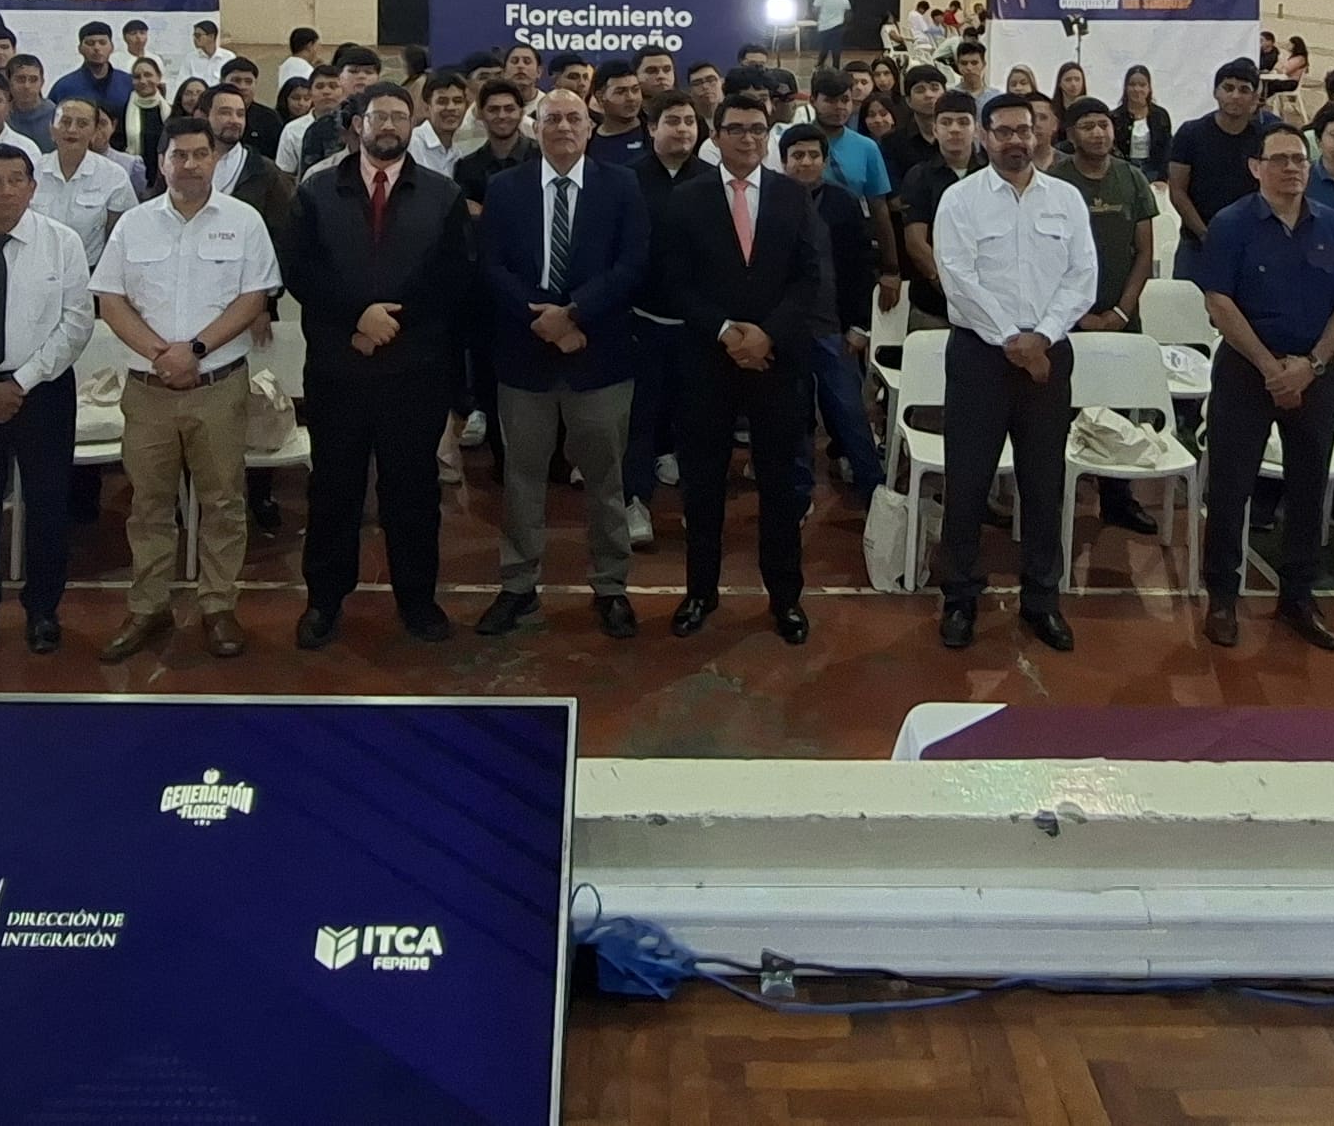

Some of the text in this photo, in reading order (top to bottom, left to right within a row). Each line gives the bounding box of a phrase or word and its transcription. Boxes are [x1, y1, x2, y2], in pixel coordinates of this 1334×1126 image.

[505, 3, 693, 27] Florecimiento
[514, 28, 683, 52] Salvadoreño
[160, 781, 254, 814] GENERACIÓN
[180, 804, 228, 820] FLORECE
[7, 908, 125, 927] DIRECCIÓN DE
[0, 929, 117, 947] INTEGRACIÓN
[362, 925, 443, 956] ITCA
[373, 956, 430, 970] FEPADE
